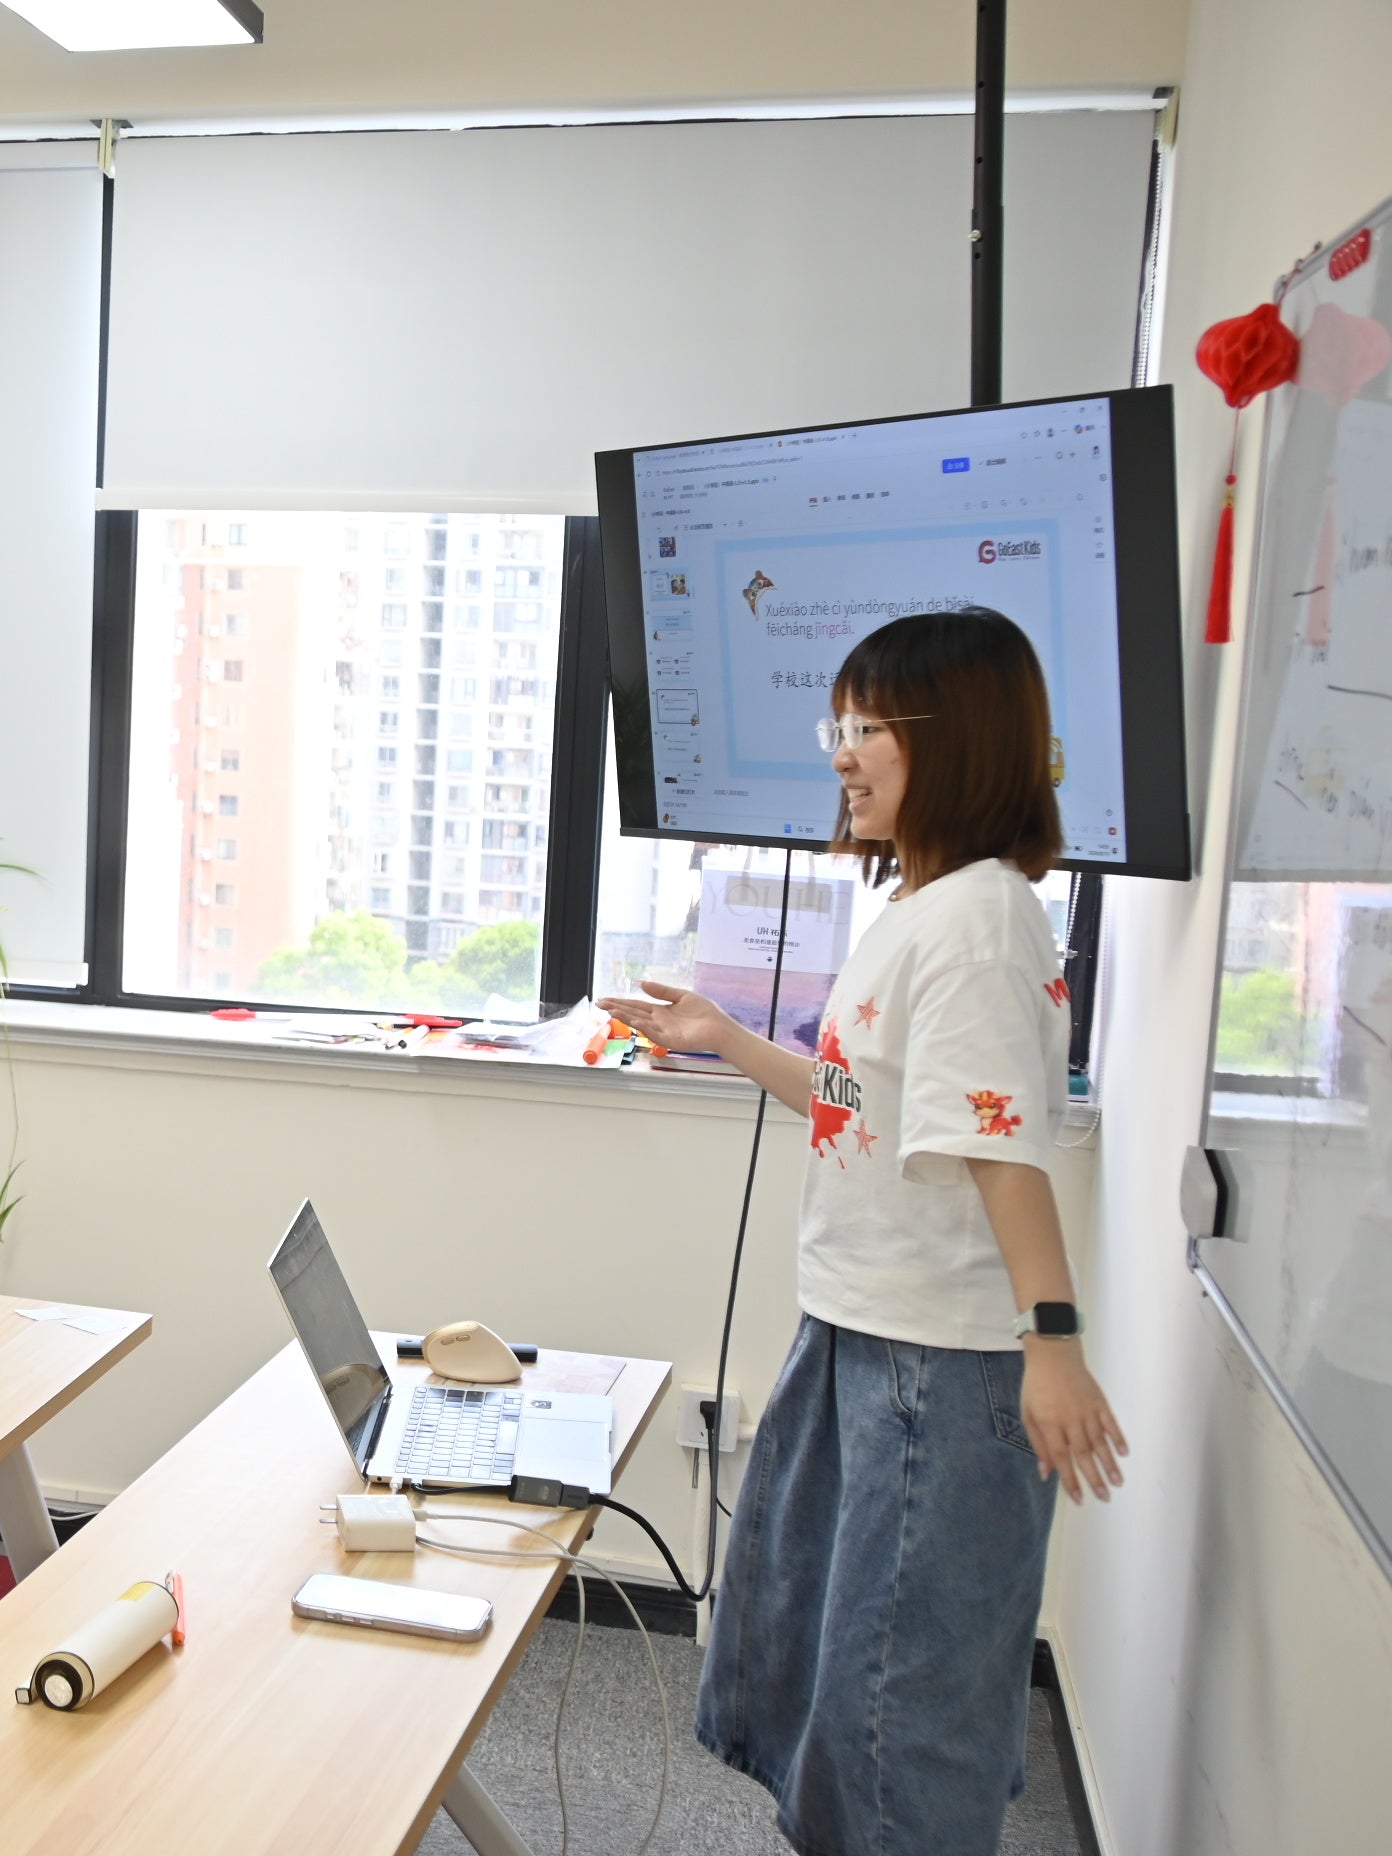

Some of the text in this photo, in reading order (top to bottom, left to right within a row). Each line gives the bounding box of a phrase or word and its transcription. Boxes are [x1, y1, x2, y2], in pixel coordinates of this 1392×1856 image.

[998, 542, 1024, 556] GoEast
[1024, 540, 1041, 555] Kids
[766, 601, 808, 617] Xuéxiào
[810, 600, 829, 616] zhè
[831, 601, 841, 616] cì
[844, 598, 924, 618] yùndòngyuán
[927, 597, 942, 612] de
[767, 622, 814, 639] fēicháng
[822, 1064, 862, 1112] Kids
